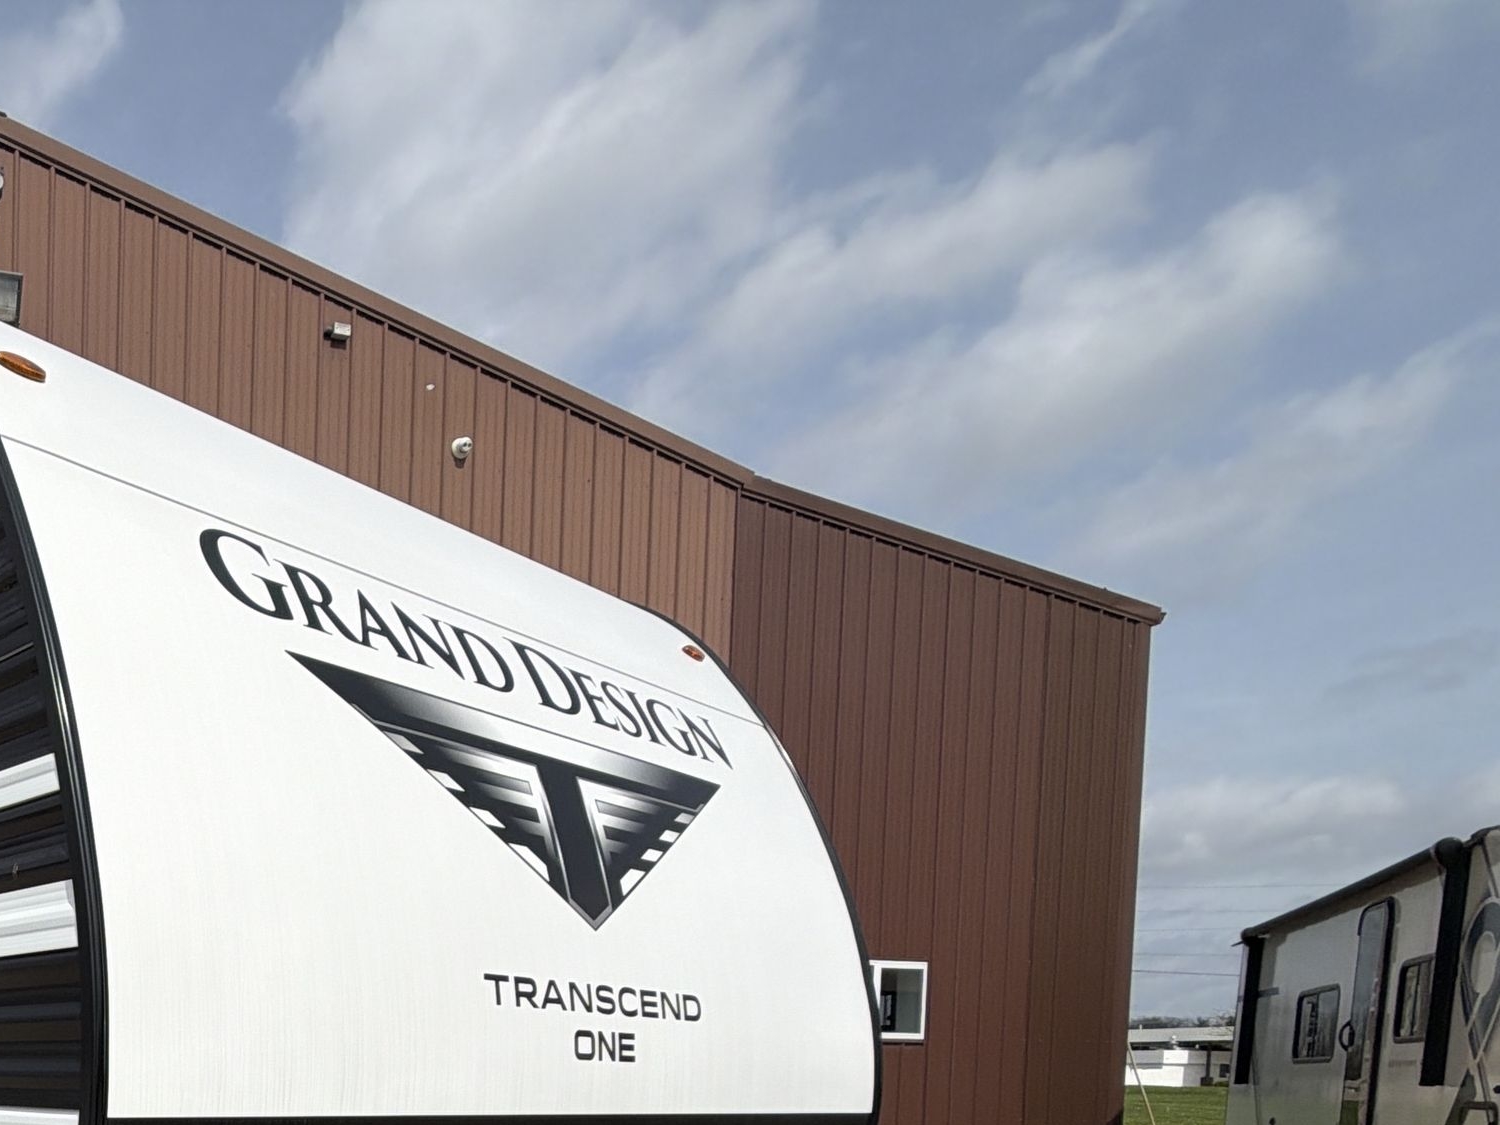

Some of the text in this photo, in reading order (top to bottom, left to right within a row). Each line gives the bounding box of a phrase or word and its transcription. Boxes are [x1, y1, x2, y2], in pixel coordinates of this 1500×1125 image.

[199, 528, 733, 769] GRAND DESIGN
[483, 973, 702, 1022] TRANSCEND
[574, 1029, 636, 1062] ONE
